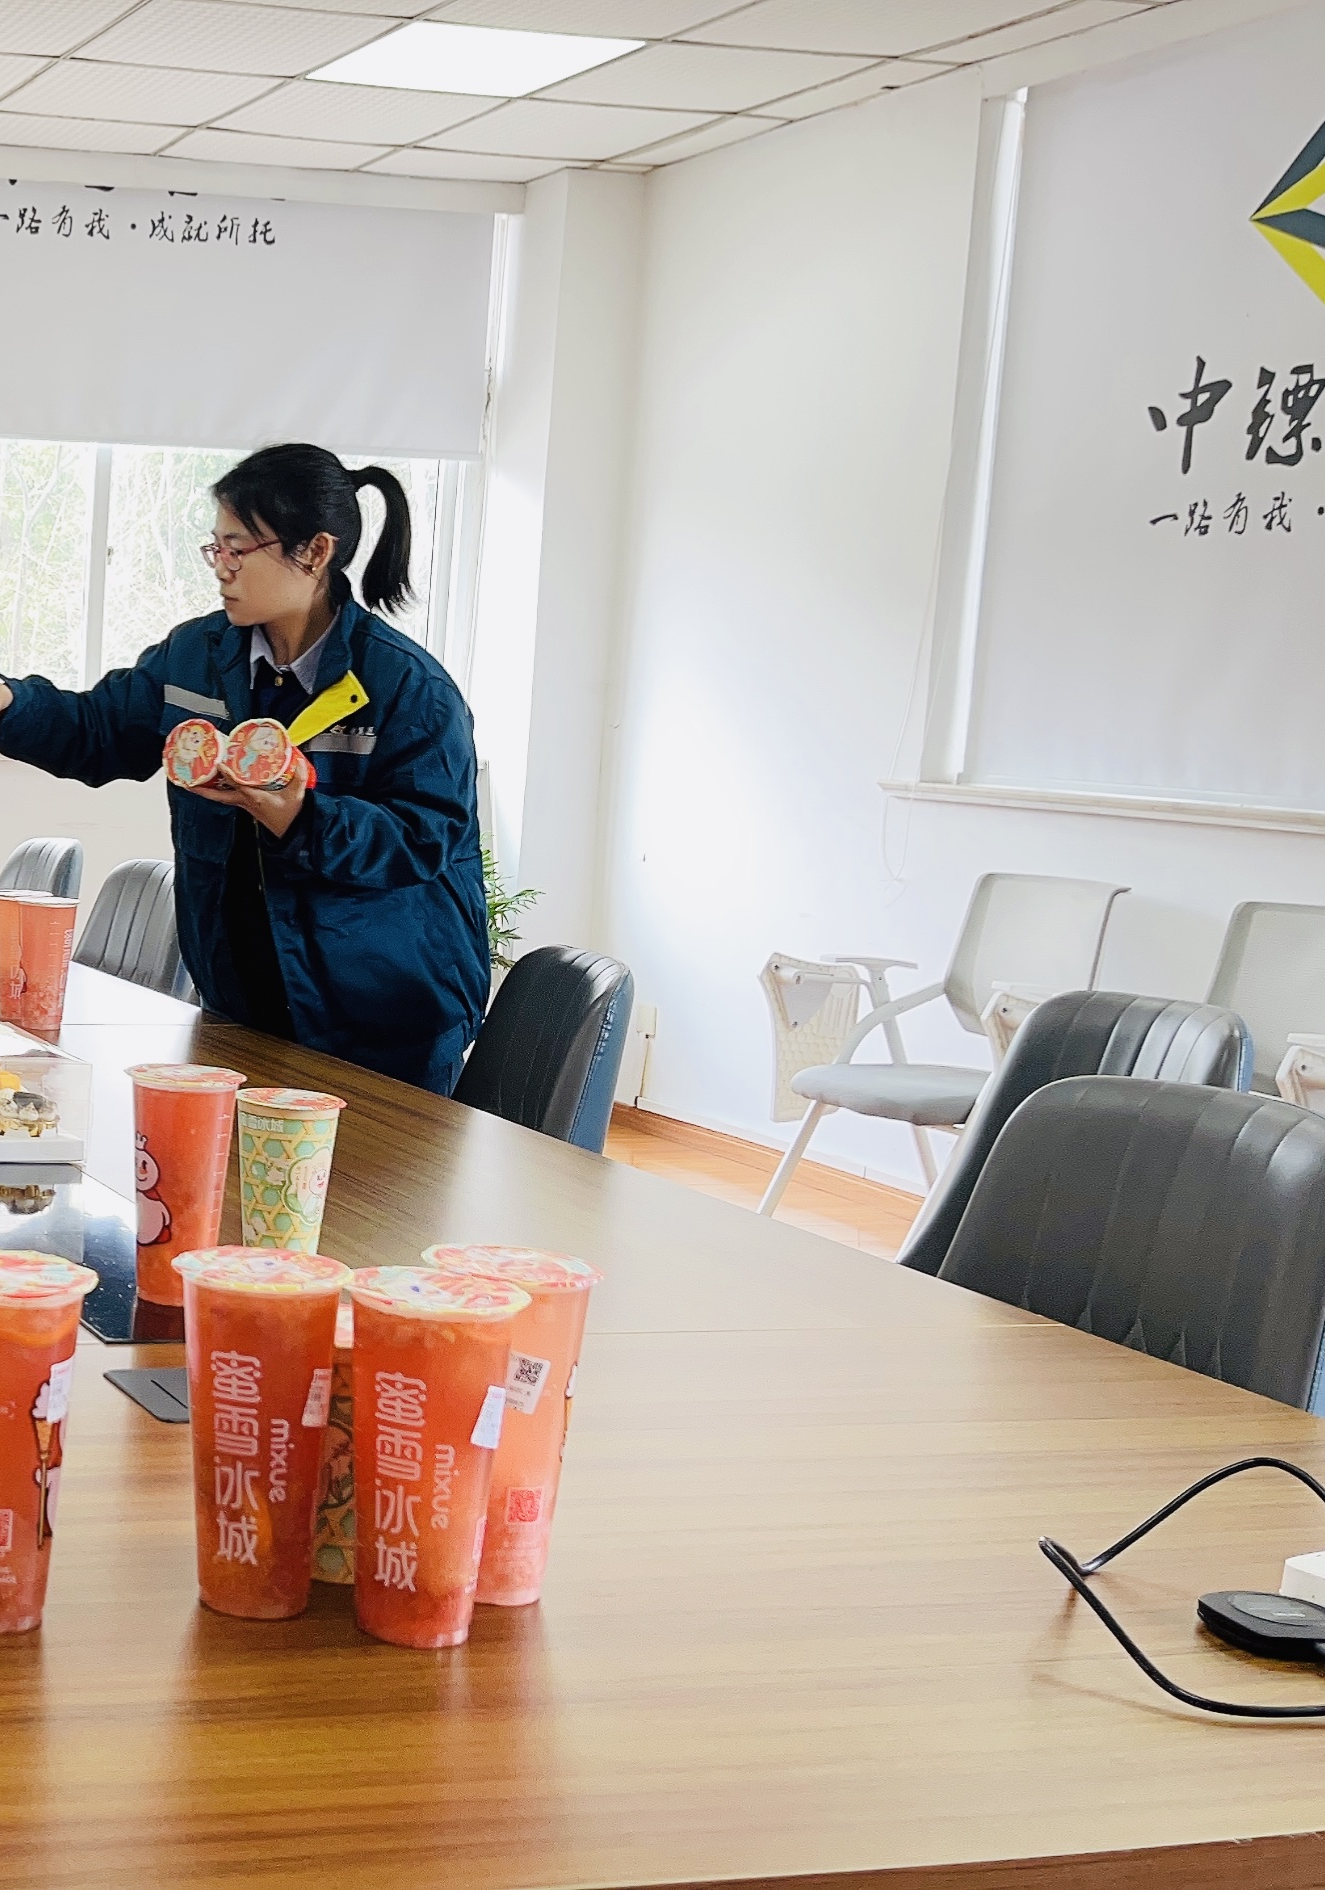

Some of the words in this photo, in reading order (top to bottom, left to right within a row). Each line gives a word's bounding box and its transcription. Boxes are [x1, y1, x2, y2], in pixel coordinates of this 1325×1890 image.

[210, 1350, 262, 1567] 蜜雪冰城
[268, 1418, 296, 1504] mixue
[374, 1370, 428, 1593] 蜜雪冰城
[430, 1443, 460, 1531] mixue
